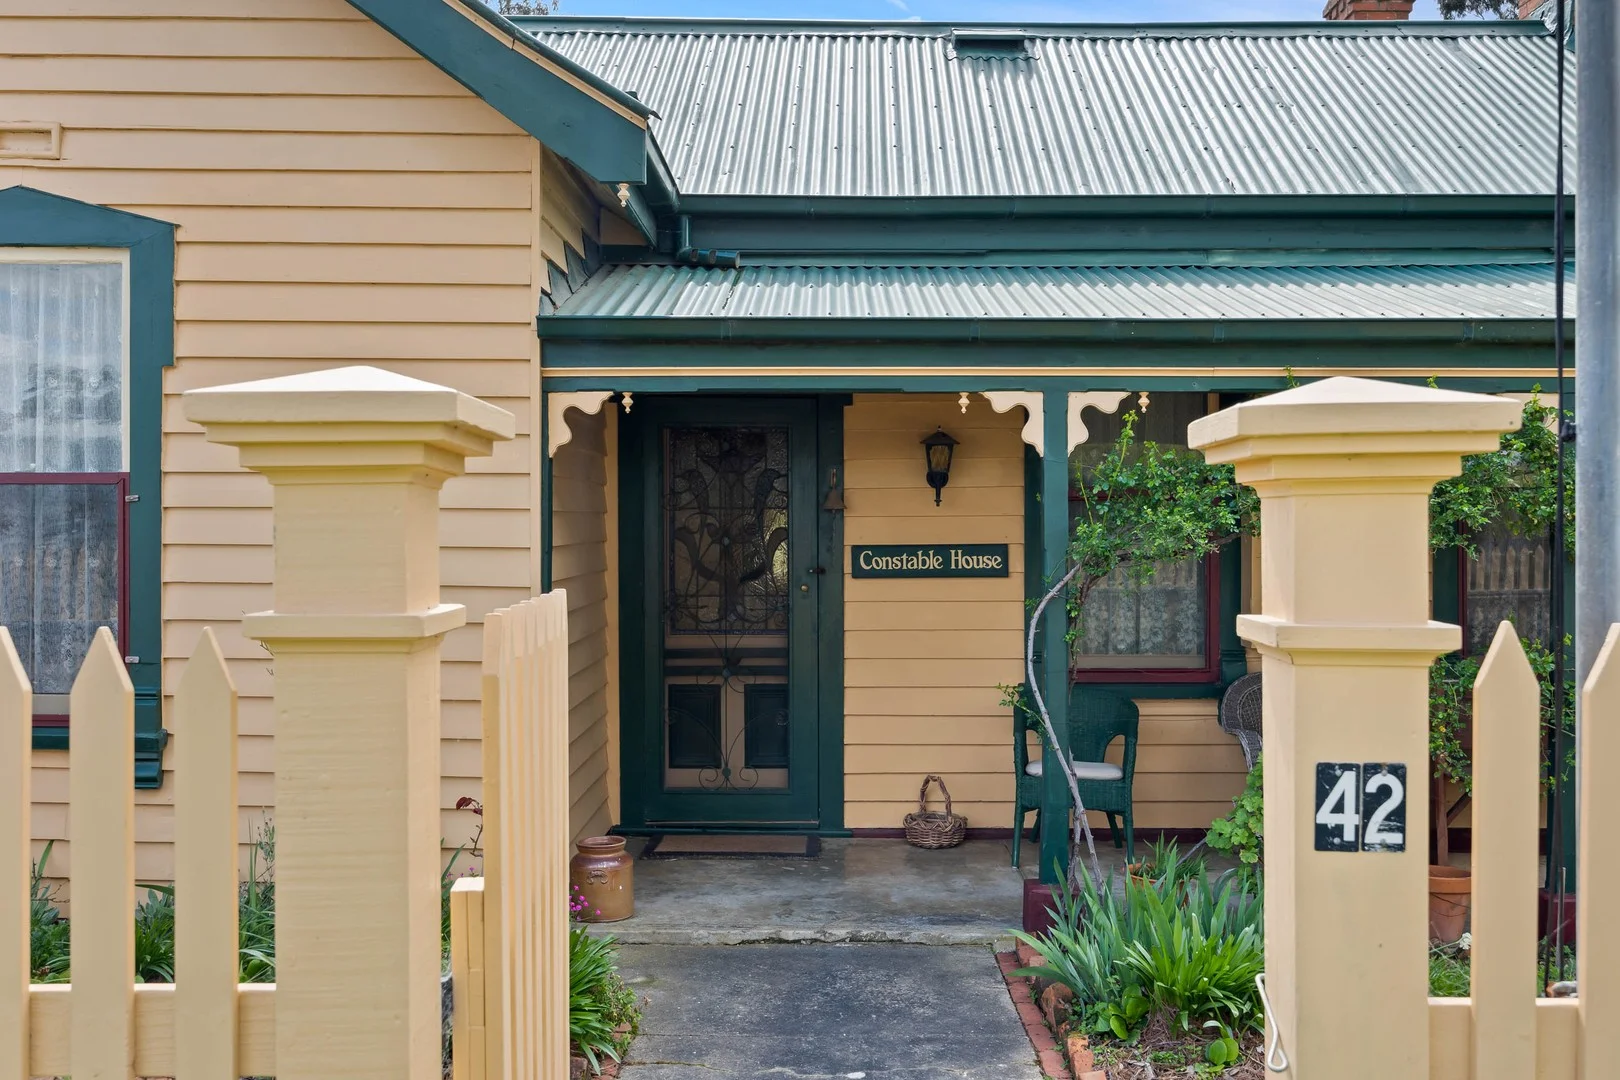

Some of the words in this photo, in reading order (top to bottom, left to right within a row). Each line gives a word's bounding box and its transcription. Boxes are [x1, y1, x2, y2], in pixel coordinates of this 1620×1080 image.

[859, 550, 944, 570] Constable
[949, 549, 1003, 569] House
[1315, 770, 1404, 844] 42
